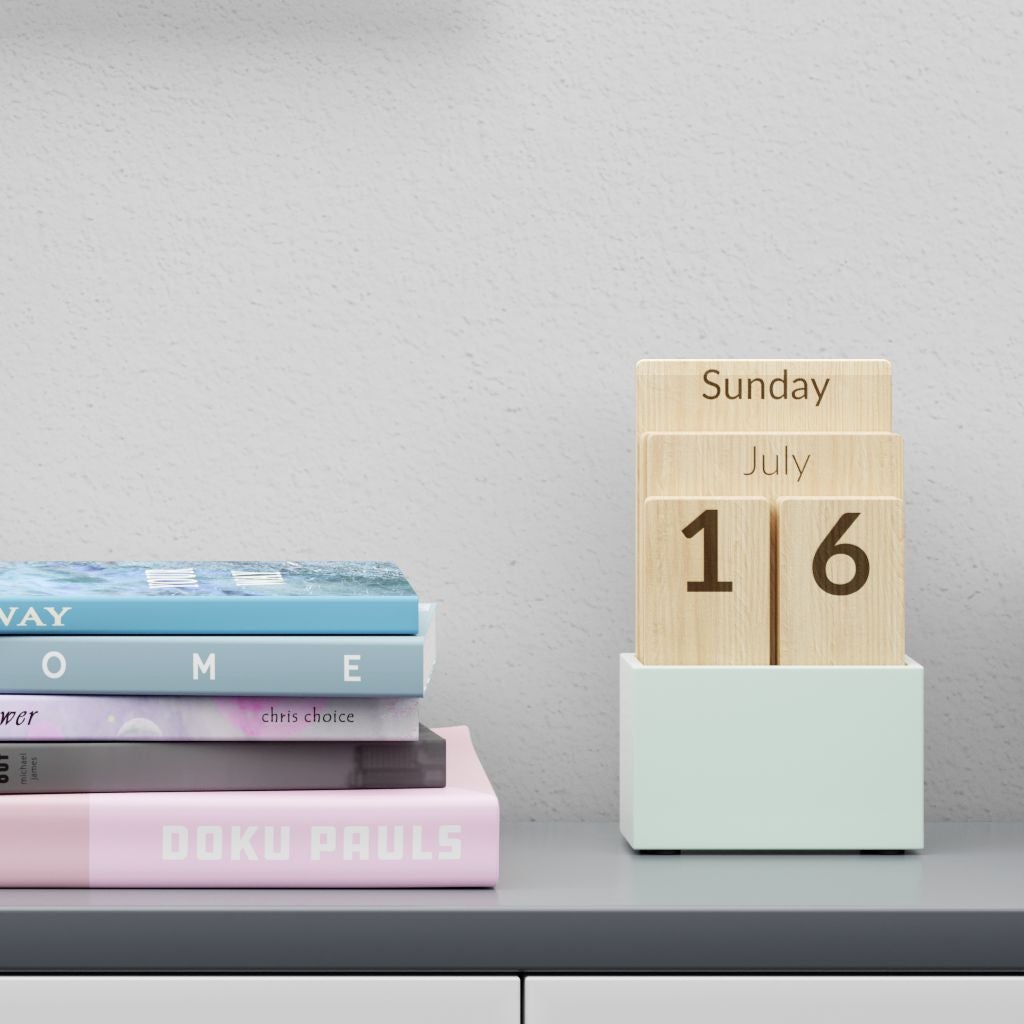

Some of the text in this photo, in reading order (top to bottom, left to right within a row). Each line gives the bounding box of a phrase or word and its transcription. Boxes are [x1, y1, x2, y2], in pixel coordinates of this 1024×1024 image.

[702, 368, 830, 406] Sunday
[743, 445, 811, 482] July
[261, 706, 355, 723] chris choice
[162, 825, 463, 861] DOKU PAULS
